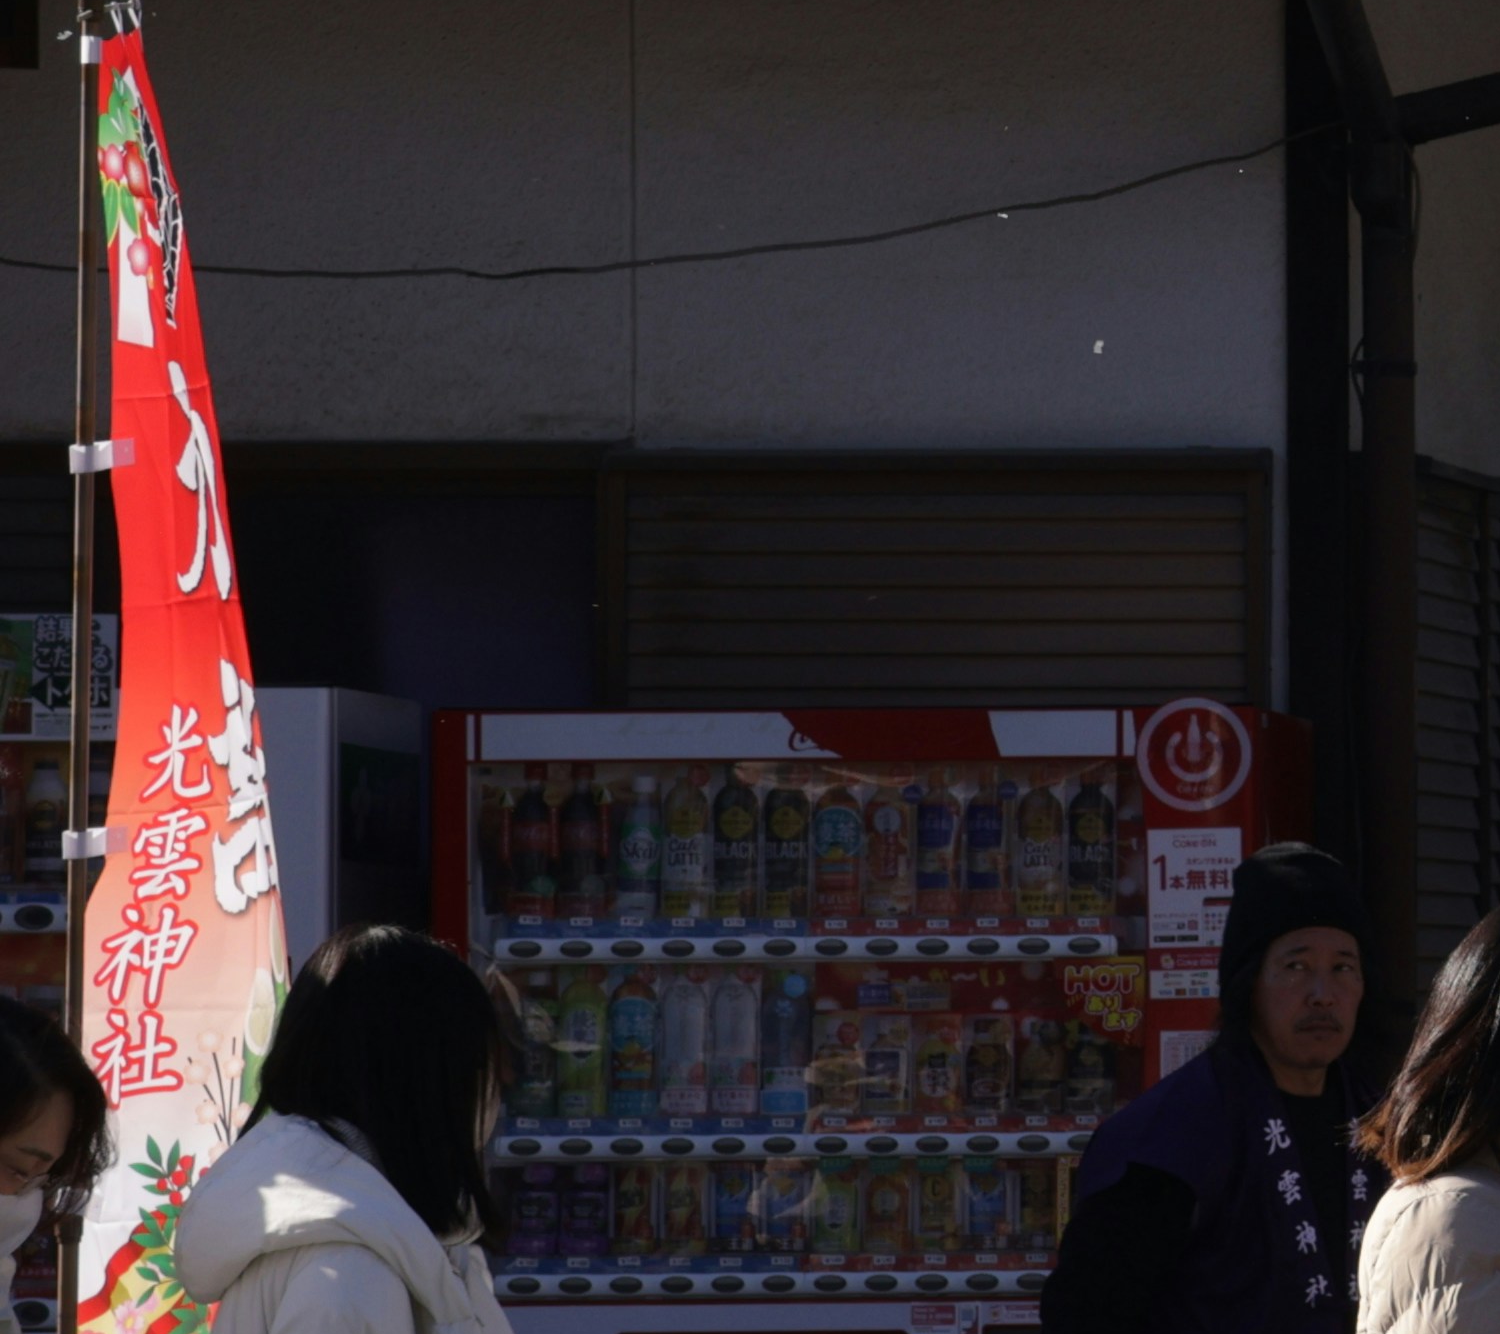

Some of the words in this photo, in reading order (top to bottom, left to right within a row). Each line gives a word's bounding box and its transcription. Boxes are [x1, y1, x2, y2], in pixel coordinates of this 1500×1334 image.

[95, 704, 212, 1107] 光雲神社
[1064, 964, 1140, 995] HOT
[1086, 993, 1121, 1014] あり
[1104, 1009, 1142, 1030] ます
[1263, 1117, 1333, 1309] 光雲神社
